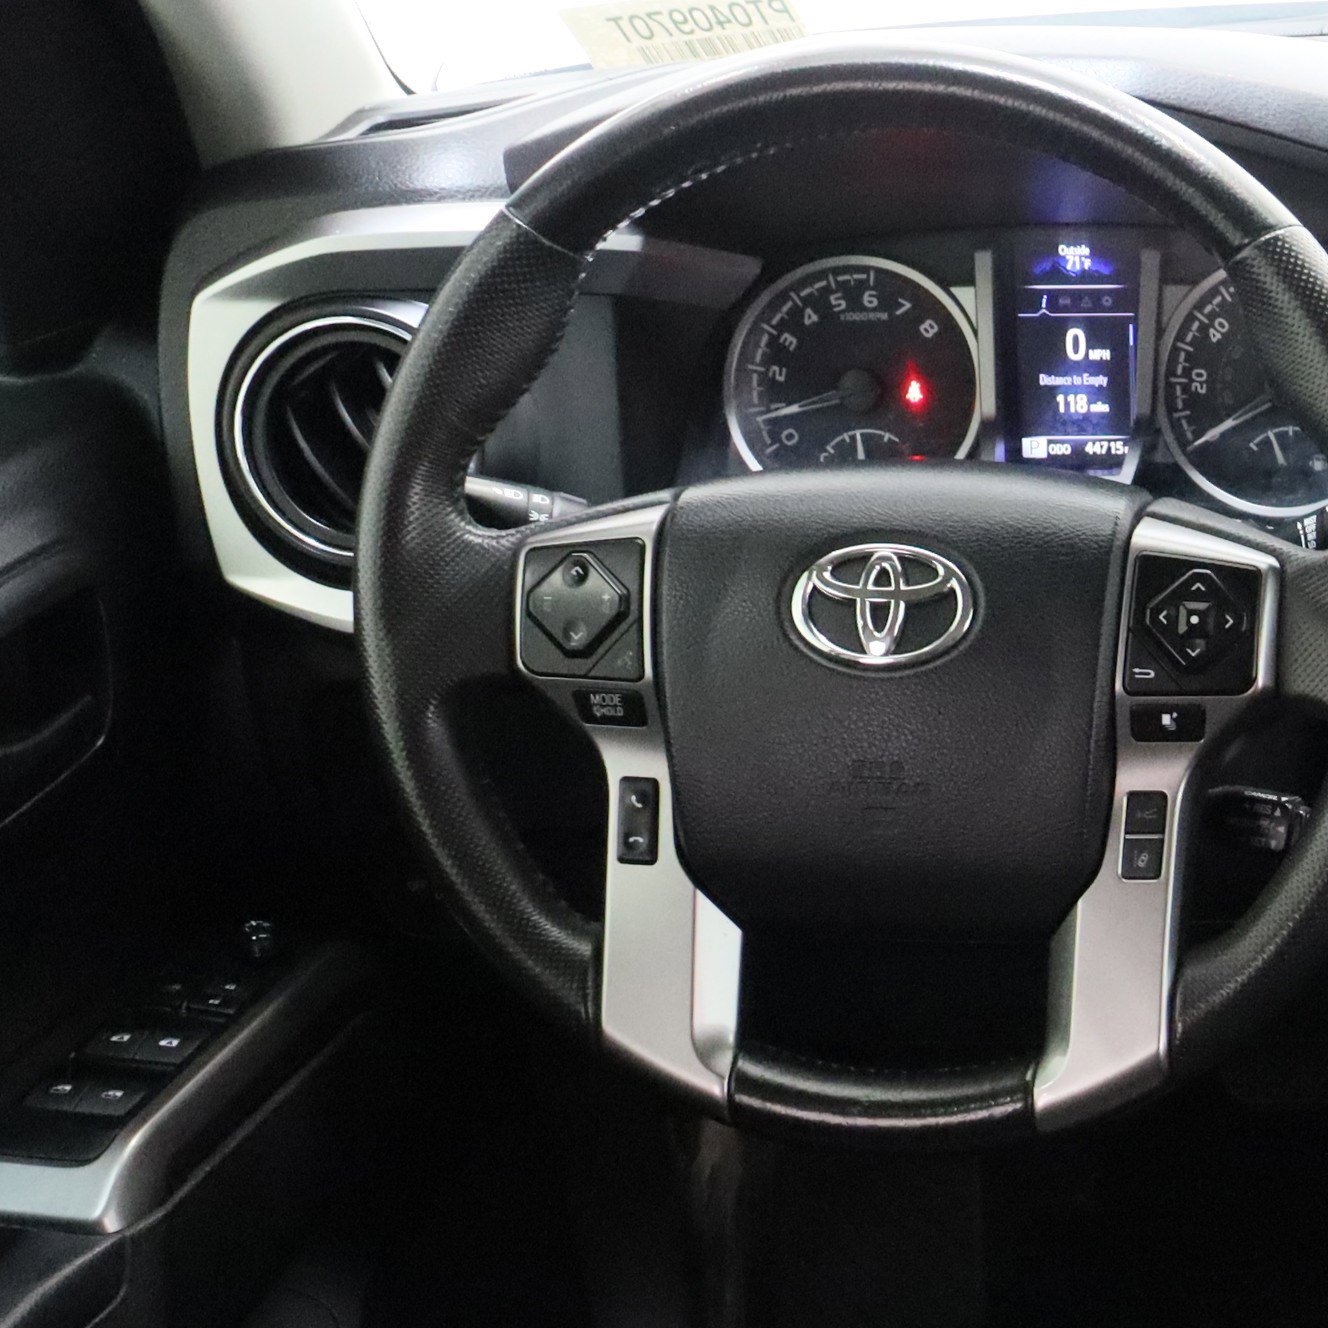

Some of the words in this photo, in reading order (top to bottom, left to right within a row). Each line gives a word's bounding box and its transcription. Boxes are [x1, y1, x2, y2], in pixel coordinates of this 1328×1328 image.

[1058, 244, 1090, 256] Outside
[829, 292, 846, 311] 5
[863, 291, 878, 307] 6
[895, 298, 912, 315] 7
[803, 307, 818, 326] 4
[919, 319, 939, 338] 8
[1208, 317, 1229, 343] 40
[779, 332, 798, 351] 3
[1065, 328, 1087, 361] 0
[1088, 349, 1111, 360] MPH
[769, 365, 786, 382] 2
[1039, 373, 1072, 386] Distance
[1073, 374, 1081, 386] to
[1082, 373, 1108, 387] Empty
[1191, 368, 1208, 394] 20
[1056, 393, 1088, 413] 118
[781, 428, 799, 446] 0
[1048, 444, 1072, 455] ODO
[1084, 441, 1124, 455] 44715
[590, 693, 622, 706] MODE
